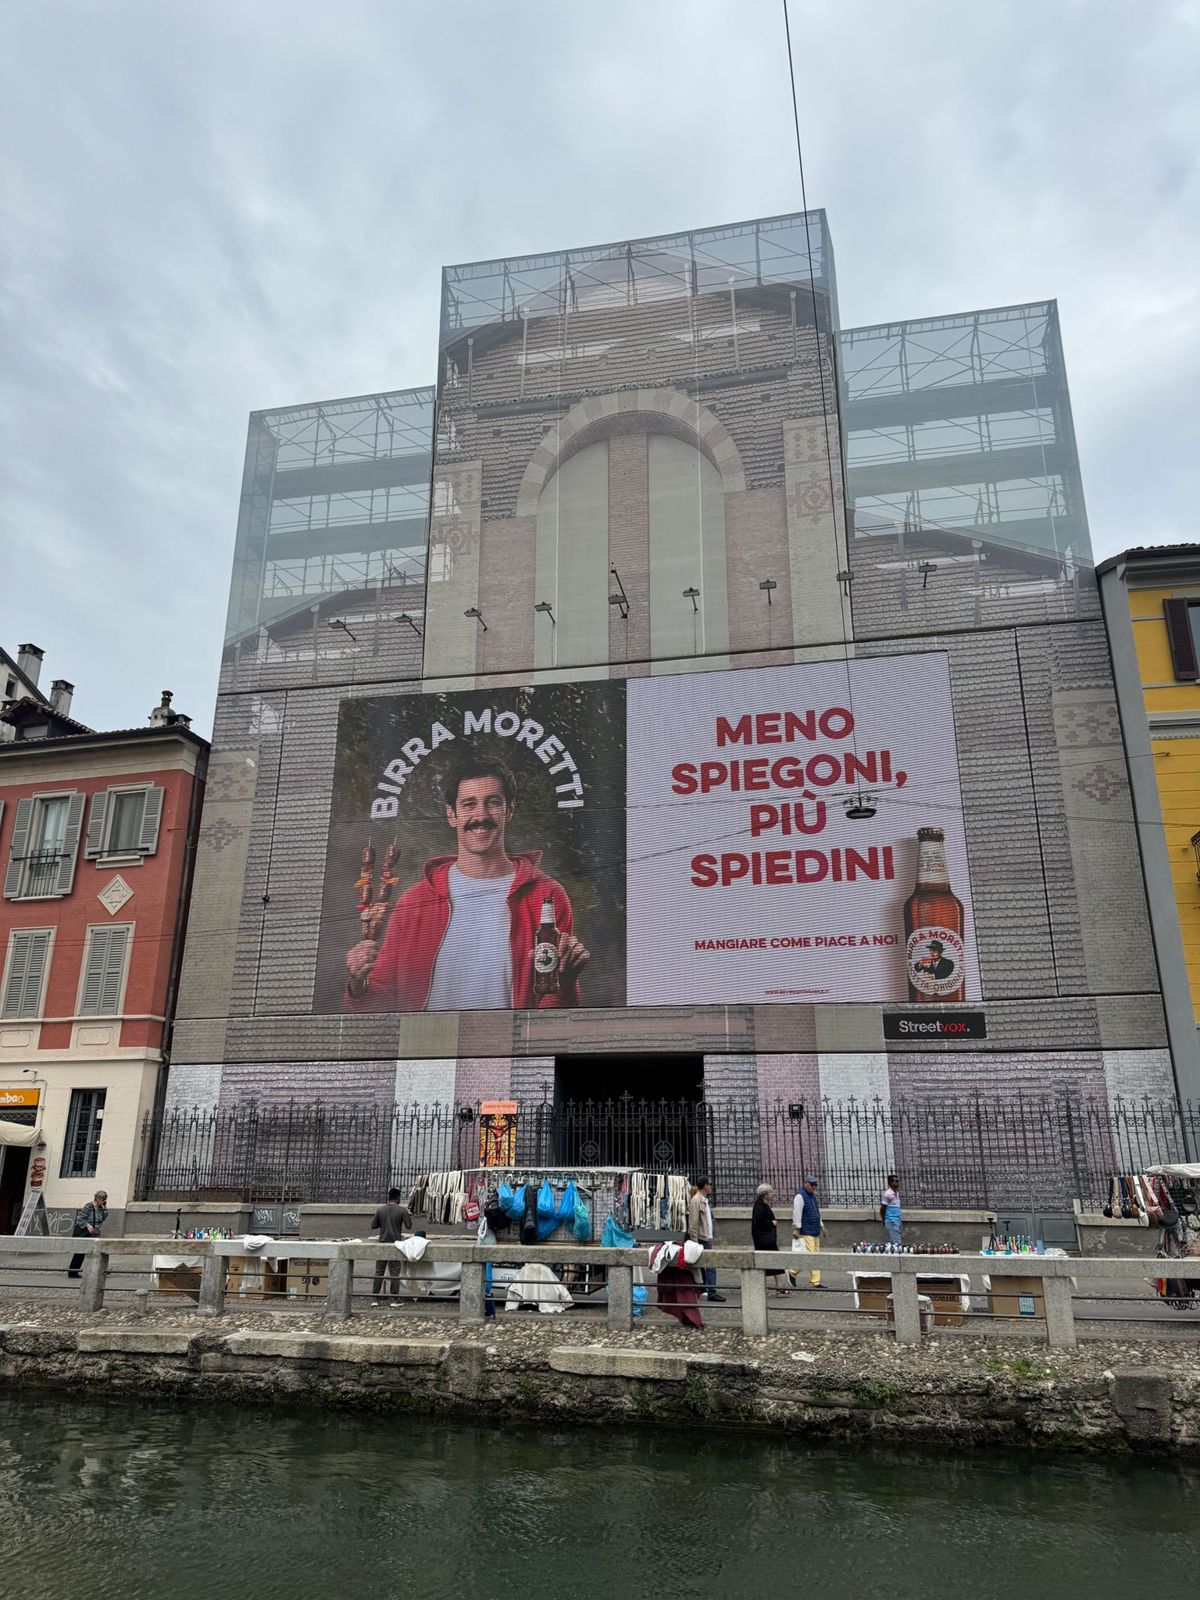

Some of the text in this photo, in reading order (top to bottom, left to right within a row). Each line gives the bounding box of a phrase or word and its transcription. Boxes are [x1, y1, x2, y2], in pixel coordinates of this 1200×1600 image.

[716, 707, 854, 746] MENO
[371, 708, 584, 819] BIRRA MORETTI
[671, 750, 907, 794] SPIEGONI,
[750, 789, 826, 837] PIÙ
[691, 845, 895, 887] SPIEDINI
[694, 934, 899, 950] MANGIARE COME PIACE A NOI
[907, 933, 926, 959] BIRRA
[898, 1020, 970, 1033] Streetvox.
